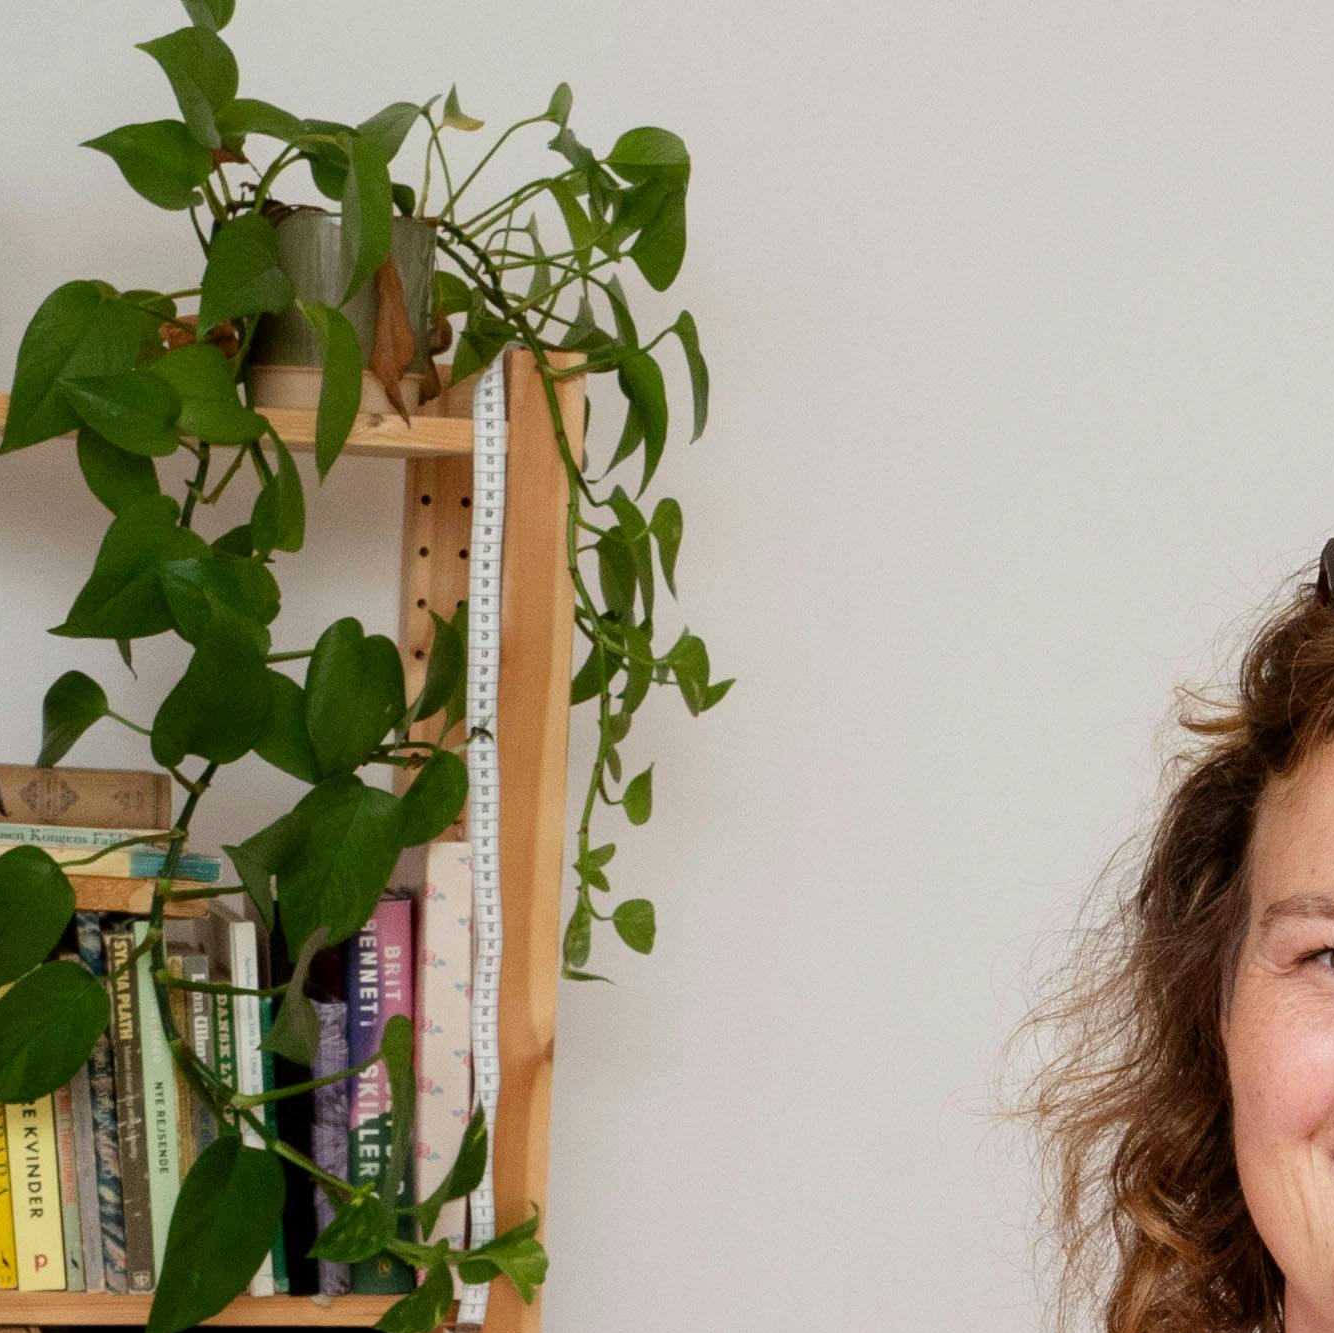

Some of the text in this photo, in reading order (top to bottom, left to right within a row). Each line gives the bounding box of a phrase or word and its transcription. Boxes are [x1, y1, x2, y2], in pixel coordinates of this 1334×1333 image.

[30, 829, 86, 844] Kongens
[114, 941, 130, 990] SYLIA
[384, 946, 401, 1001] BRIT
[117, 994, 133, 1040] PLATH
[216, 994, 231, 1058] DANSK
[154, 1082, 169, 1174] NYE REJSENDE
[24, 1127, 44, 1218] KVINDER
